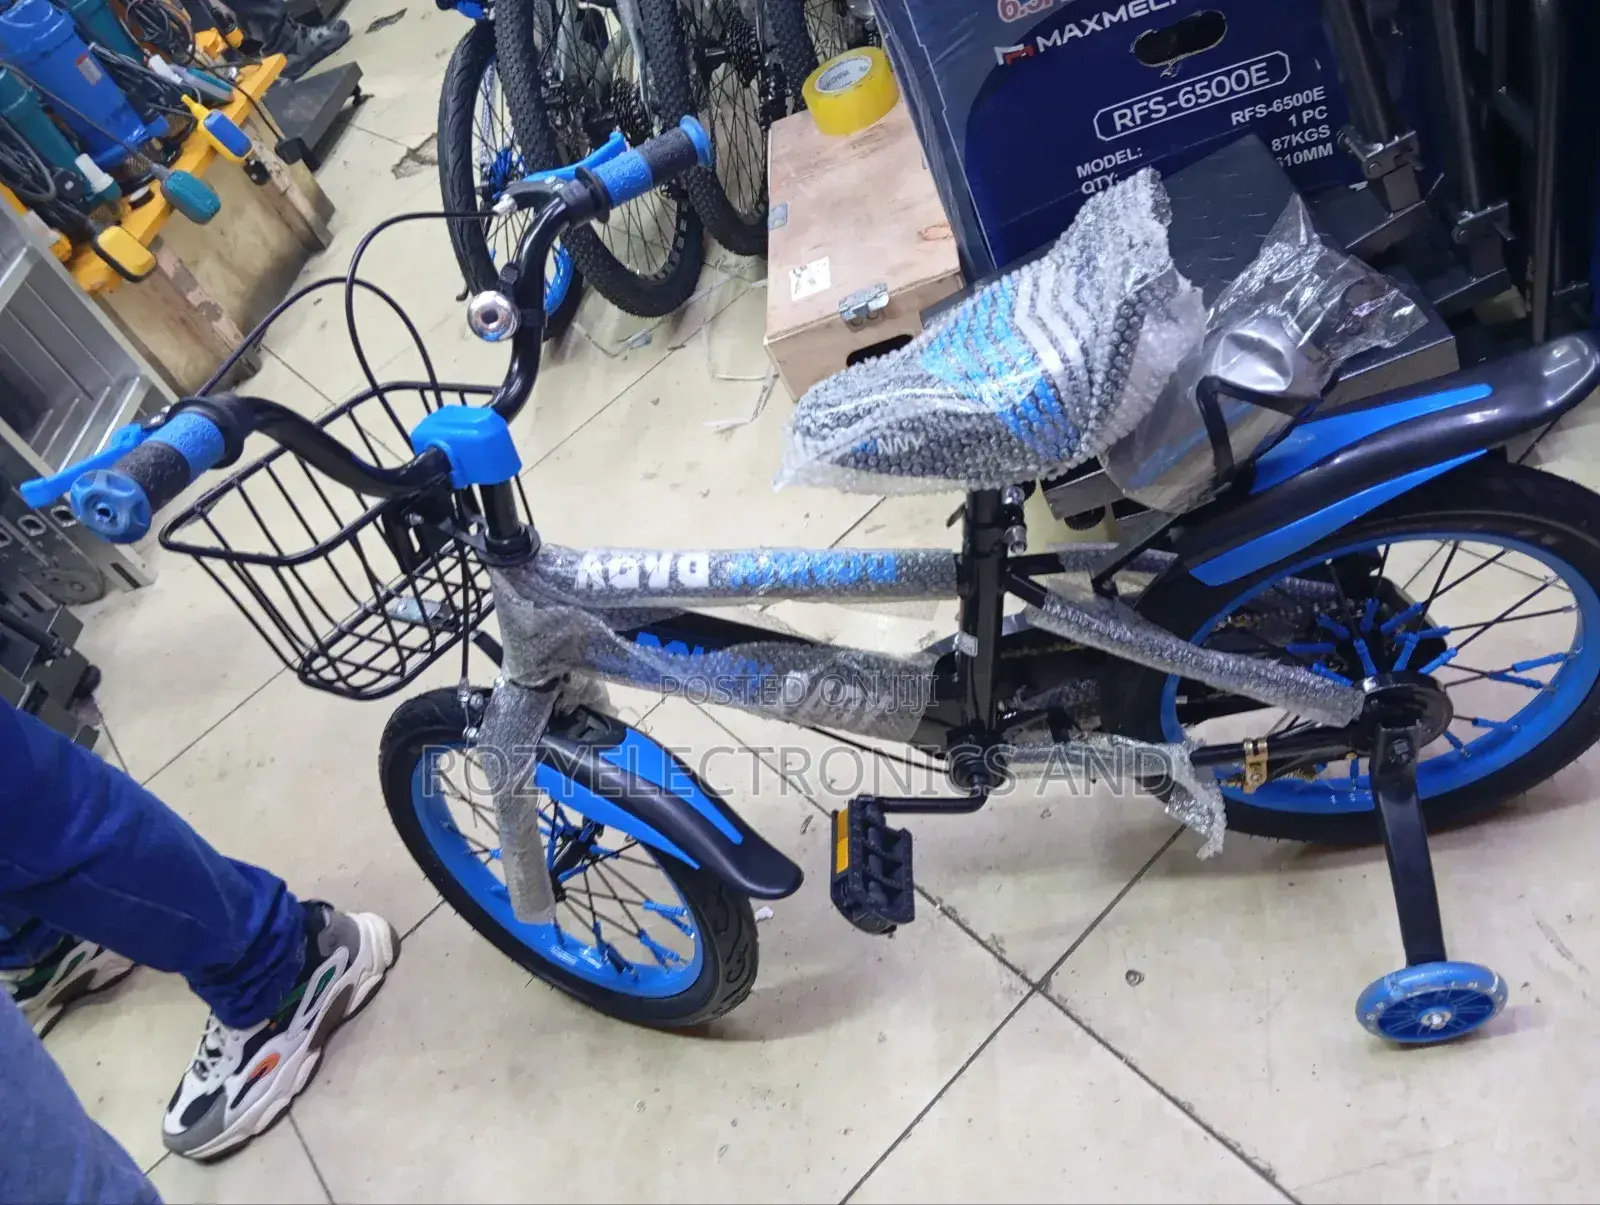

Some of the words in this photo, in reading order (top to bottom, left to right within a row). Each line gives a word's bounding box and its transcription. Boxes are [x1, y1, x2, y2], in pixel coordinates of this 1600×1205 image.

[1113, 62, 1270, 132] RFS-6500E
[1231, 86, 1327, 126] RFS-6500E
[1289, 114, 1297, 127] 1
[1302, 106, 1328, 124] PC
[1271, 124, 1331, 152] 87KGS
[1076, 147, 1143, 179] MODEL:
[1081, 172, 1119, 195] QTY:
